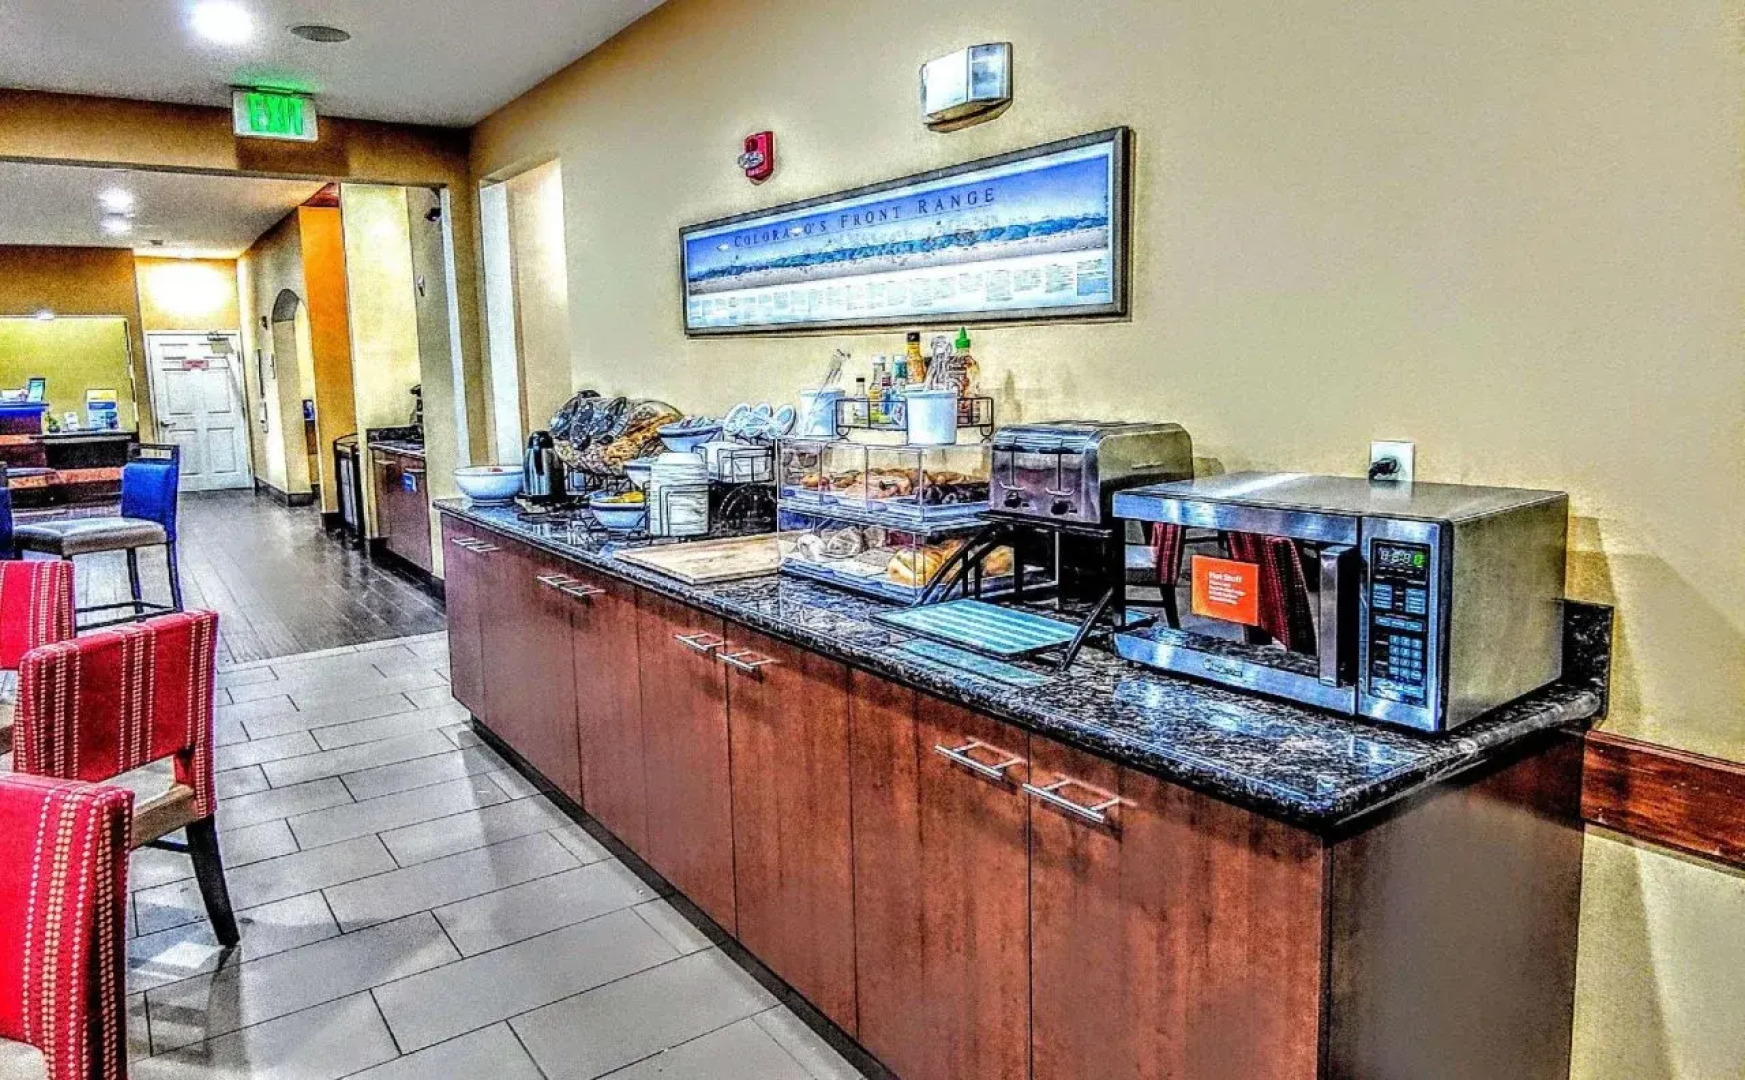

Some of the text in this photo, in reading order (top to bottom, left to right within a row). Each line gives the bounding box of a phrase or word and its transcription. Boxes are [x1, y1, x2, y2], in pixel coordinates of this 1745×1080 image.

[247, 93, 304, 135] EXIT
[734, 187, 995, 248] COLORAO'S FRONT RANGE
